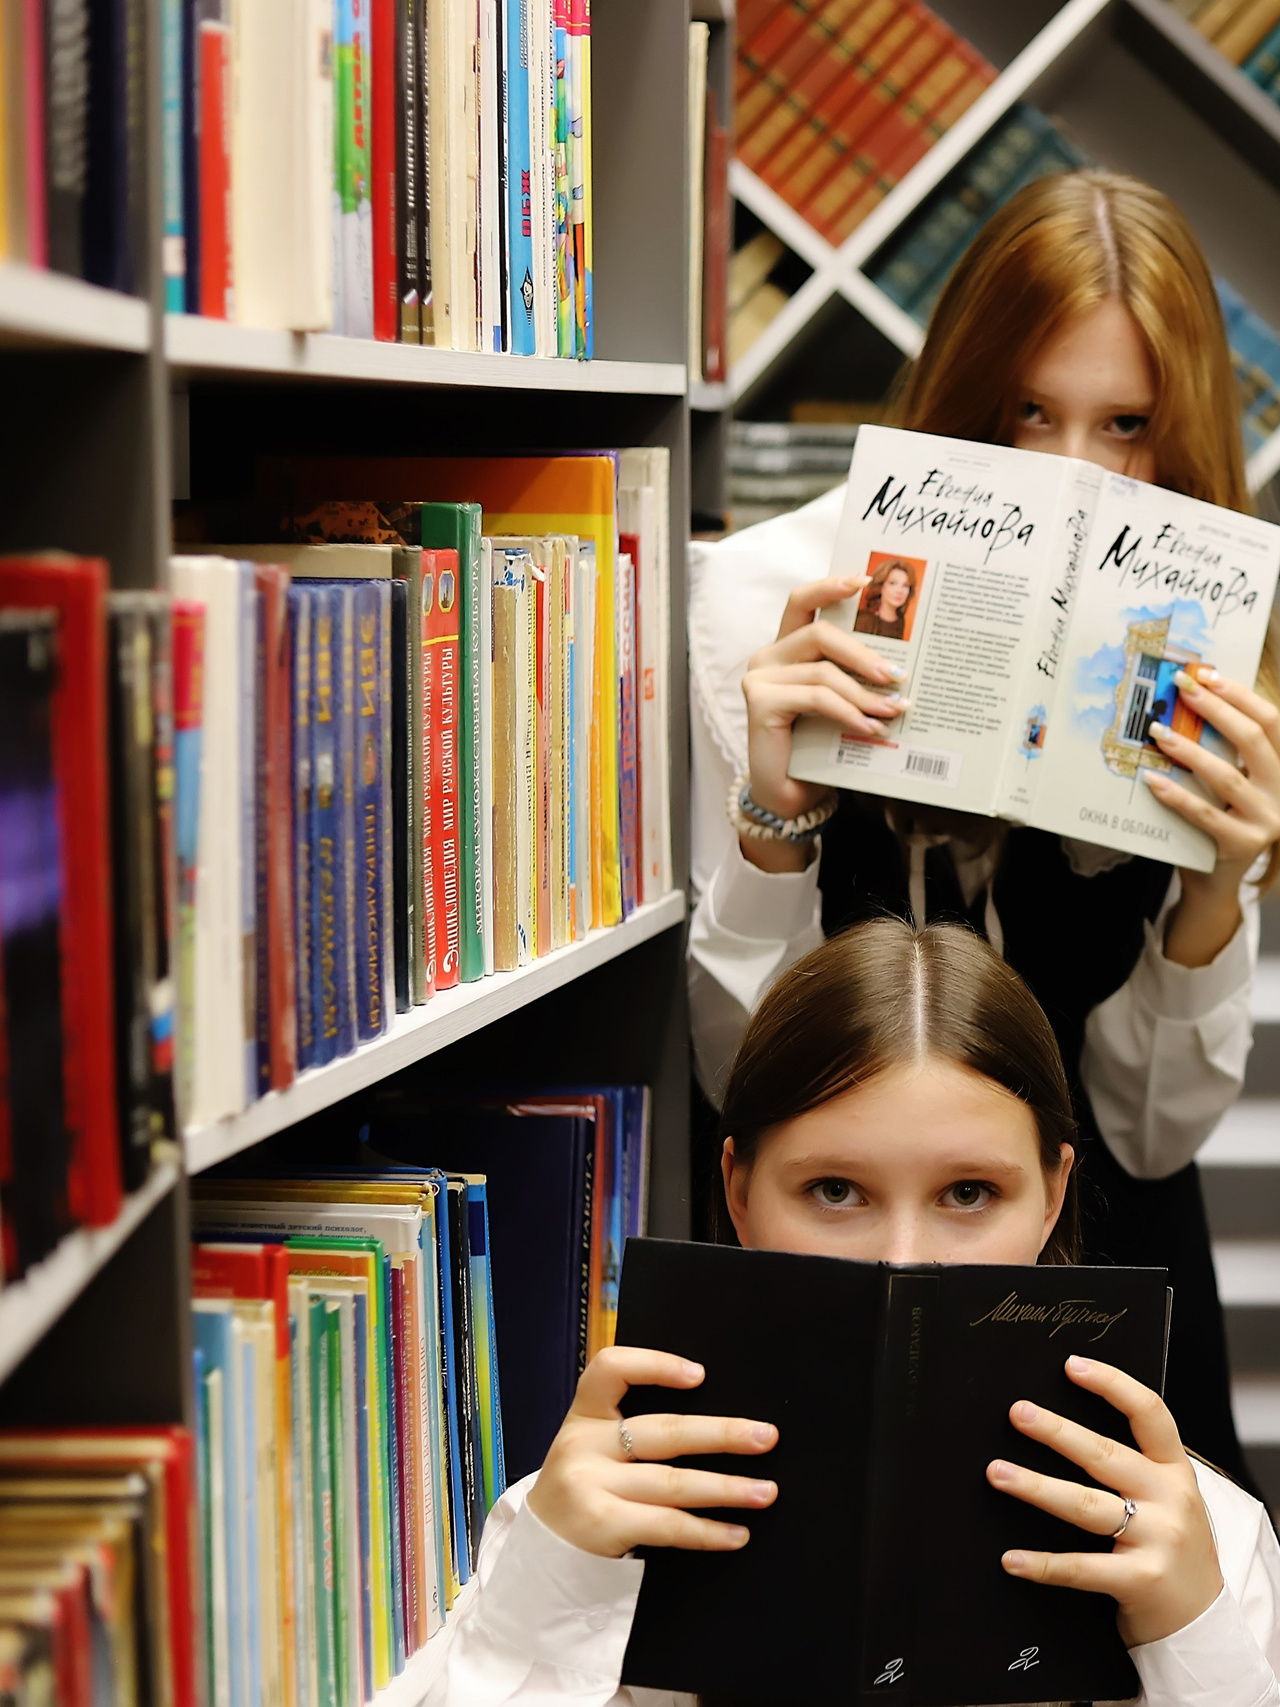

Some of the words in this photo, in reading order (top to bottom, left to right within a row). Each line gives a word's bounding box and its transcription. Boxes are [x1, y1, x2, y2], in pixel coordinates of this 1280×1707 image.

[406, 22, 416, 83] ПРАВО
[406, 90, 416, 102] И
[406, 109, 416, 207] ПОЛИТИКА
[521, 169, 532, 237] ОБЖ
[861, 475, 1036, 566] Михайлова
[918, 468, 994, 506] Евгения
[1050, 508, 1088, 615] Михайлова
[1099, 524, 1259, 630] Михайлова
[1152, 522, 1223, 569] Евгения
[471, 560, 480, 654] КУЛЬТУРА
[360, 614, 376, 717] ЭВИ
[424, 652, 432, 731] КУЛЬТУРЫ
[441, 647, 454, 725] КУЛЬТУРЫ
[621, 569, 633, 771] ПРОФЕССИИ
[423, 735, 431, 801] РУССКОЙ
[440, 730, 453, 794] РУССКОЙ
[472, 658, 481, 840] ХУДОЖЕСТВЕННАЯ
[423, 806, 432, 838] МИР
[442, 798, 454, 830] МИР
[1079, 806, 1108, 829] ОКНА
[1111, 815, 1120, 829] В
[1121, 817, 1172, 842] ОБЛАКАХ
[365, 804, 381, 1029] ГЕНЕРАЛИССИМУСЫ
[423, 845, 437, 983] ЭНЦИКЛОПЕДИЯ
[442, 838, 460, 974] ЭНЦИКЛОПЕДИЯ
[473, 844, 483, 935] МИРОВАЯ
[288, 1224, 322, 1232] детский
[582, 1152, 593, 1248] РАБОТА
[419, 1336, 430, 1458] ВОСПИТАНИЮ
[423, 1462, 430, 1488] ПО
[424, 1491, 432, 1525] ГИД
[873, 1658, 904, 1685] 2
[1007, 1646, 1040, 1671] 2
